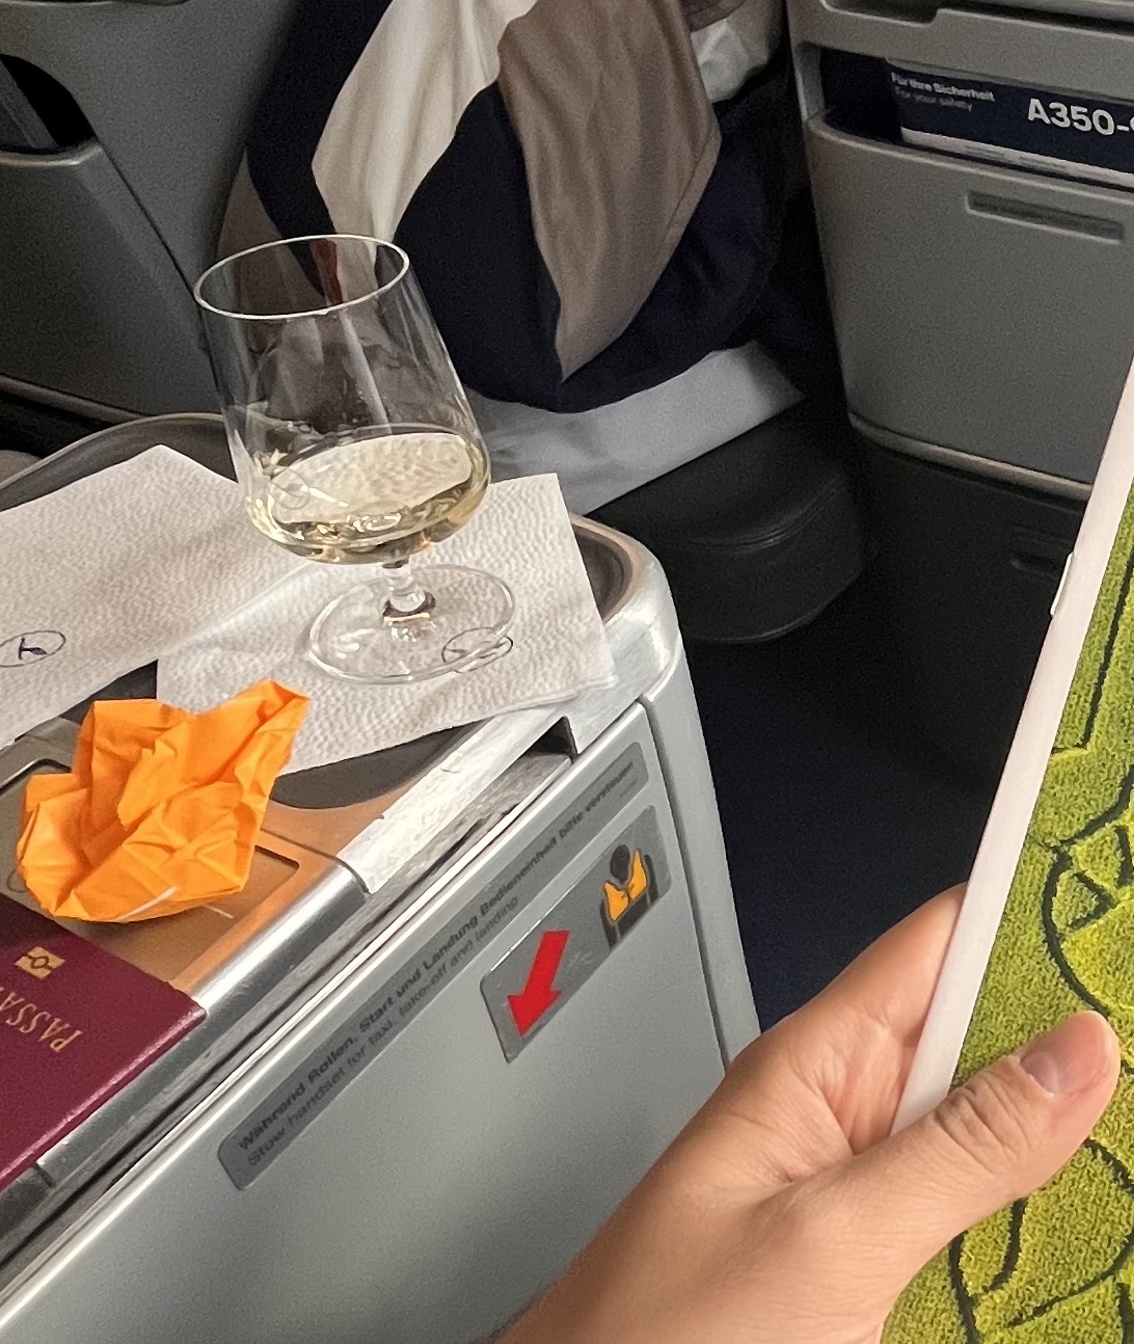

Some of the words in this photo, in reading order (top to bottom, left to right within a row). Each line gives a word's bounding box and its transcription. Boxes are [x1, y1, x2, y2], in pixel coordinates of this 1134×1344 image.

[0, 986, 83, 1053] PASSA
[247, 1126, 286, 1166] Stow
[287, 1066, 346, 1127] handset
[346, 1043, 367, 1070] for
[399, 962, 448, 1018] take-off
[449, 939, 474, 968] and
[474, 895, 519, 942] landing
[307, 1037, 358, 1084] Rollen,
[358, 996, 395, 1034] Start
[396, 967, 422, 998] und
[422, 914, 479, 971] Landung
